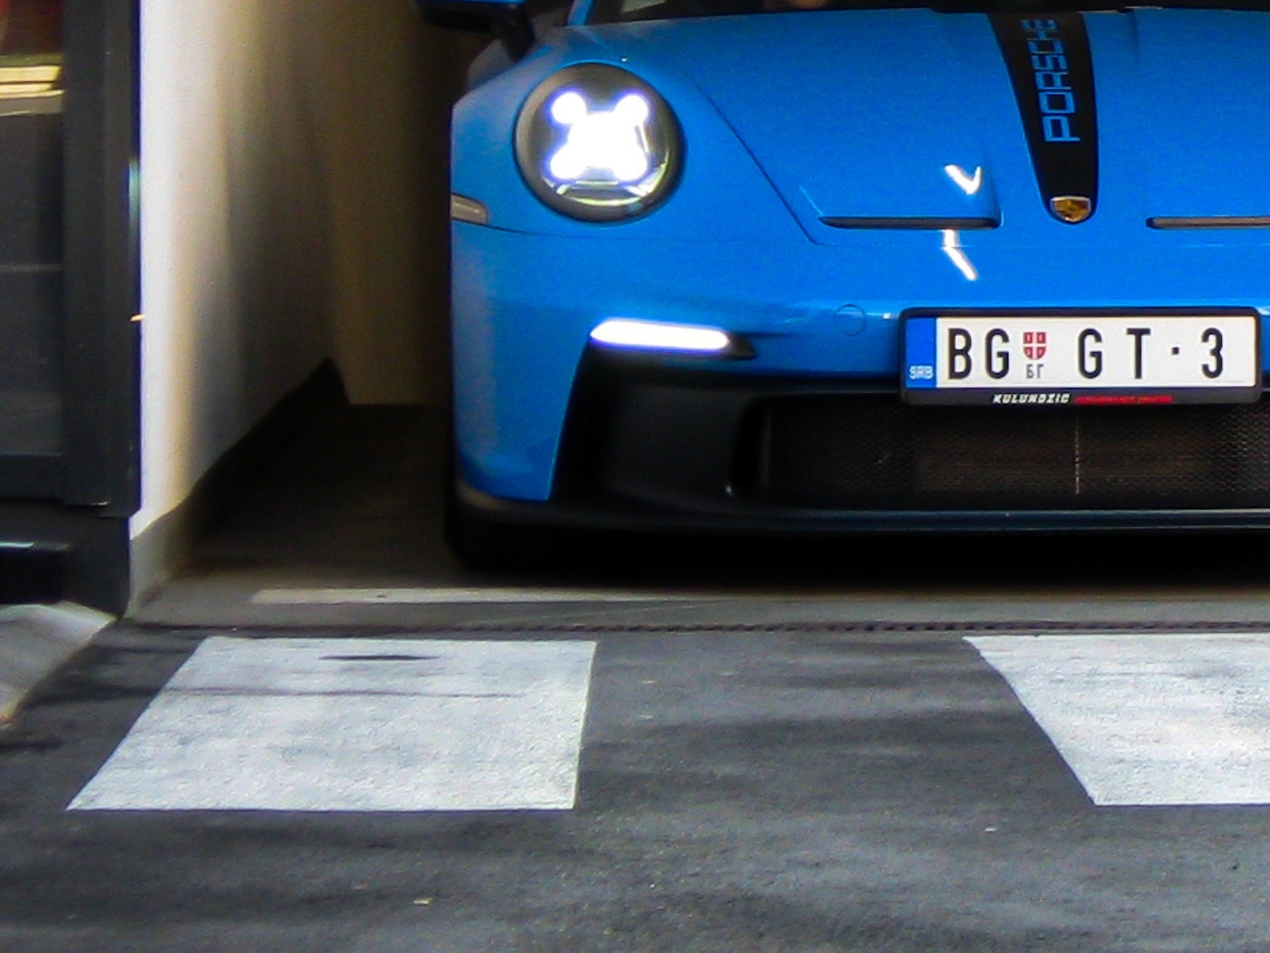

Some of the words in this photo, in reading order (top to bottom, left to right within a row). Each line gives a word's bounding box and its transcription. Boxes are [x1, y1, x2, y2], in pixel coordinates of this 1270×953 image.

[1020, 19, 1081, 142] PORSCHE
[908, 365, 933, 380] SRB
[948, 328, 1010, 380] BG
